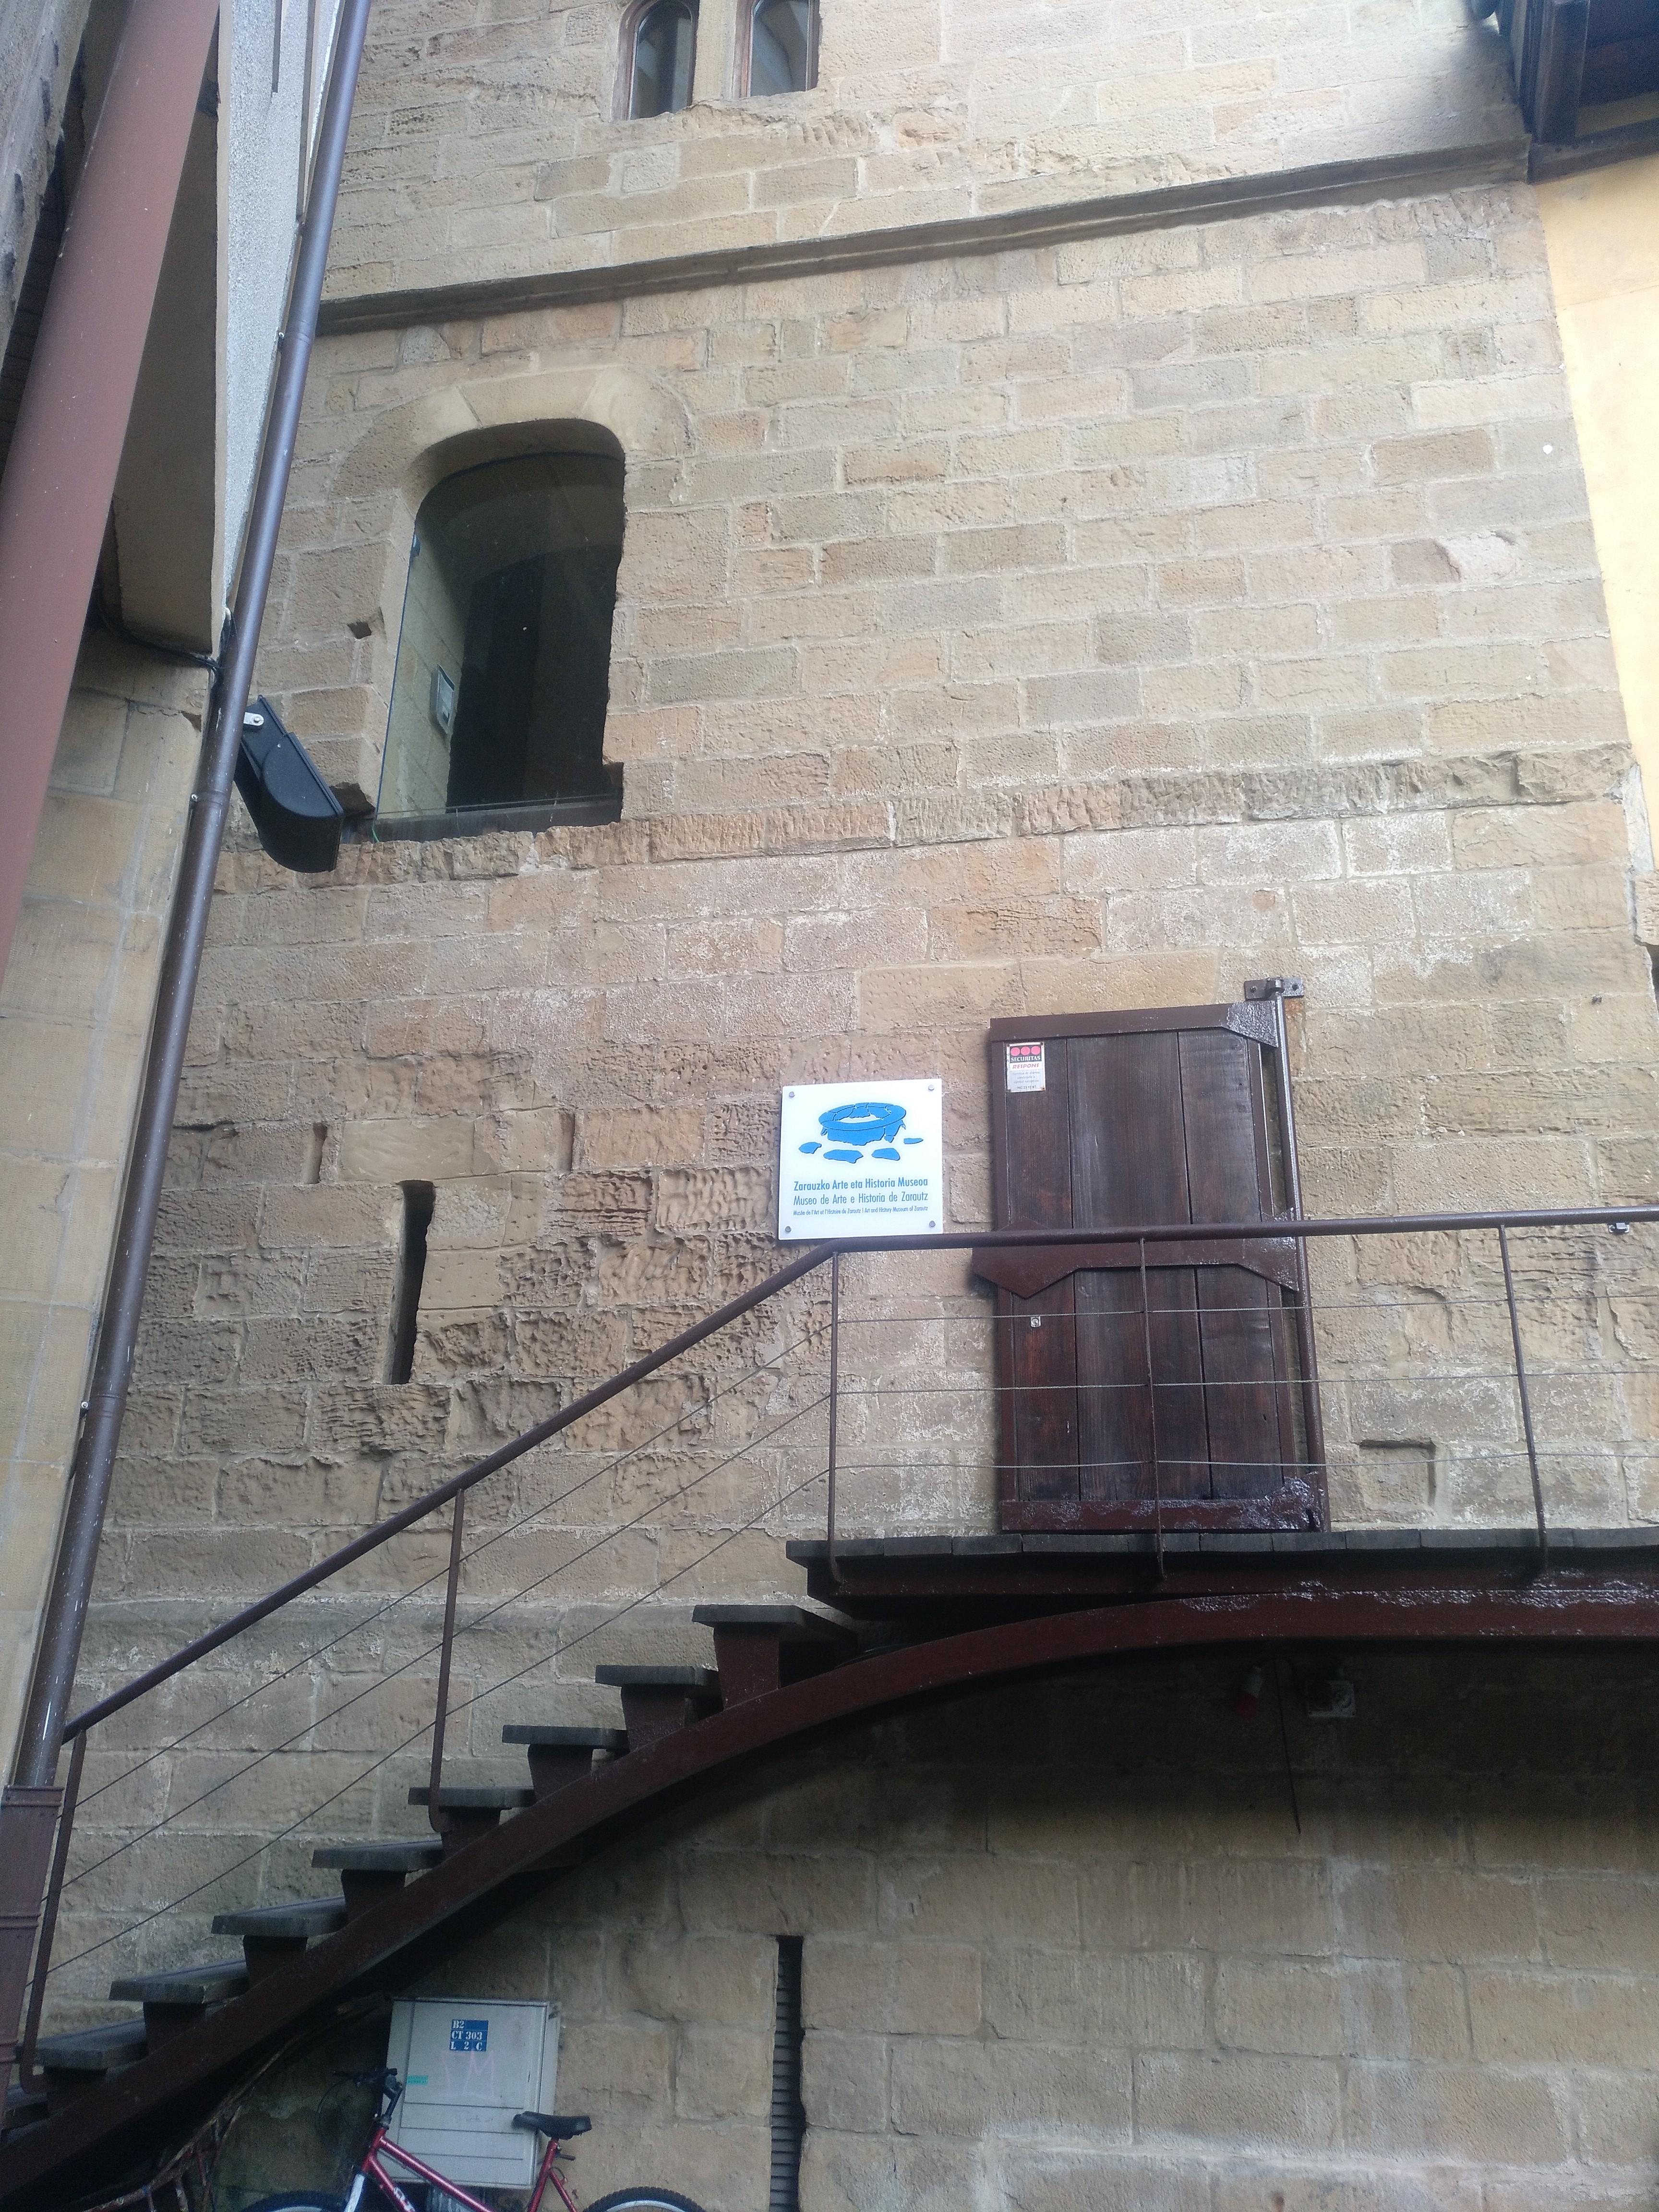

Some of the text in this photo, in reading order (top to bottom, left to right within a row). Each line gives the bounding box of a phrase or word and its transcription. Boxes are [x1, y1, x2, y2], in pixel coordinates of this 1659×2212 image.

[793, 1177, 928, 1191] Zarauzko Arte eta Historia Museoa
[793, 1195, 817, 1205] Museo
[820, 1194, 829, 1204] de
[832, 1194, 847, 1204] Arte
[858, 1193, 885, 1203] Historia
[889, 1191, 898, 1202] de
[901, 1191, 928, 1202] Zarautz
[452, 2020, 465, 2029] B2
[452, 2031, 483, 2041] CT 303
[450, 2041, 483, 2051] L 2 C
